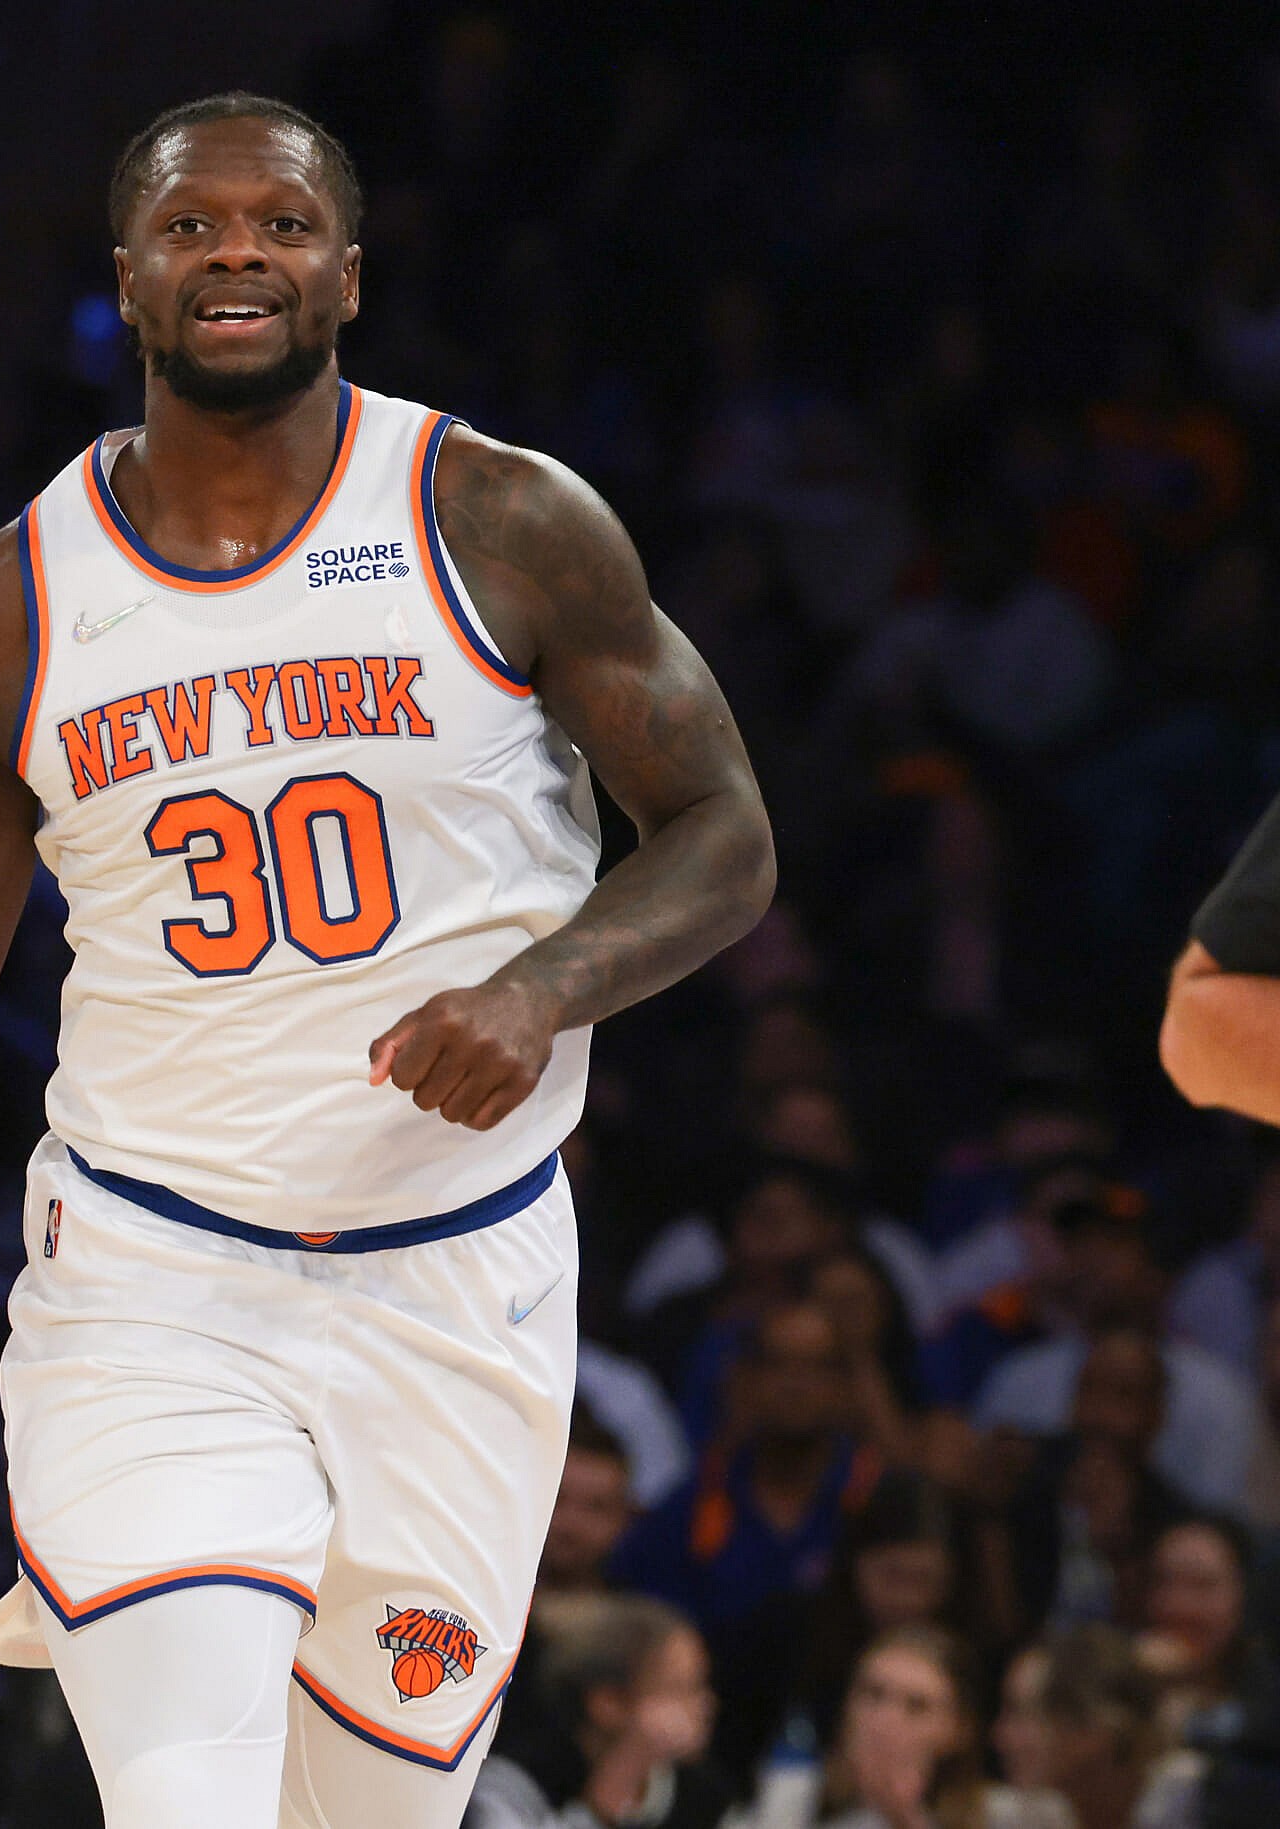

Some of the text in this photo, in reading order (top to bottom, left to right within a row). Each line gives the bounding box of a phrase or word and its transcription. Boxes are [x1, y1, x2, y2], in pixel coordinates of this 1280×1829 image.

[306, 542, 404, 568] SQUARE
[308, 564, 386, 588] SPACE
[57, 655, 436, 801] NEW YORK
[143, 771, 402, 979] 30
[376, 1608, 478, 1676] KNICKS
